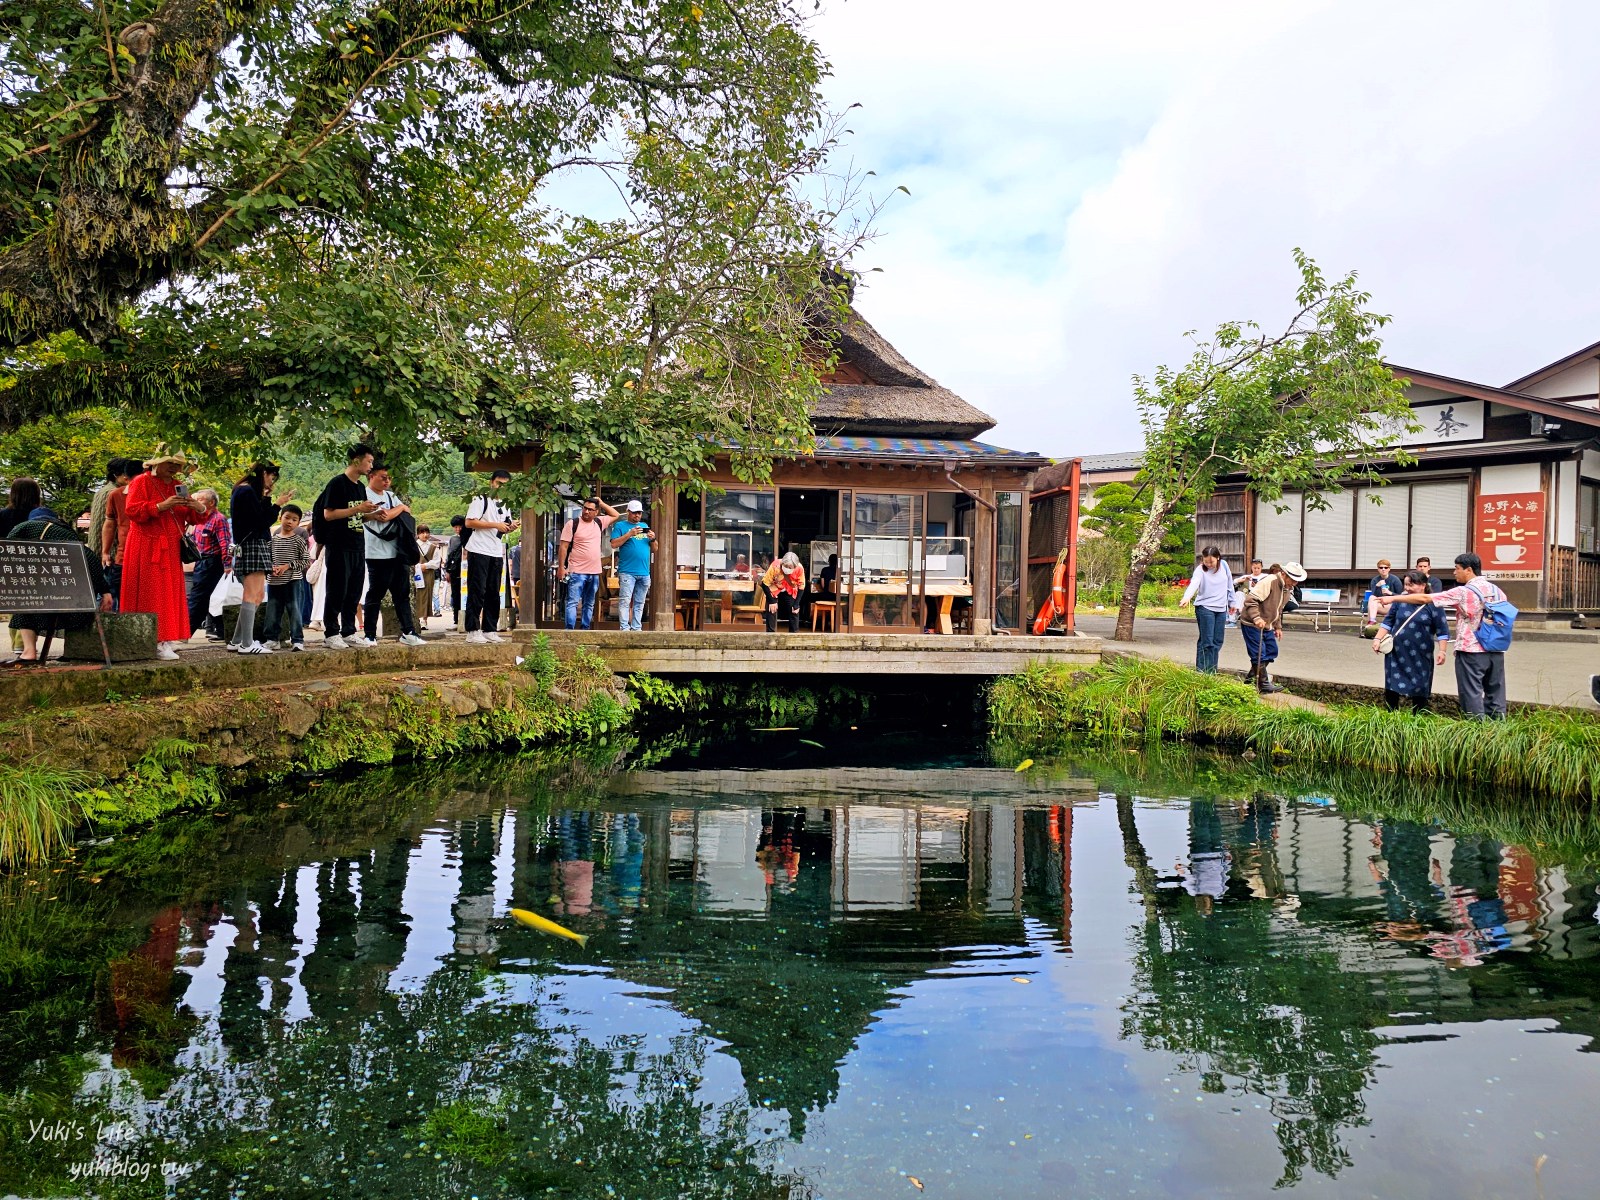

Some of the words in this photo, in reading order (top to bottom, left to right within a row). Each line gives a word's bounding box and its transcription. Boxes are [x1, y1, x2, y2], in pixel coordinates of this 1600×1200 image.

[1434, 406, 1469, 437] 茶
[1483, 500, 1539, 514] 忍野八海
[1483, 526, 1539, 542] コーヒー
[60, 577, 77, 586] 금지
